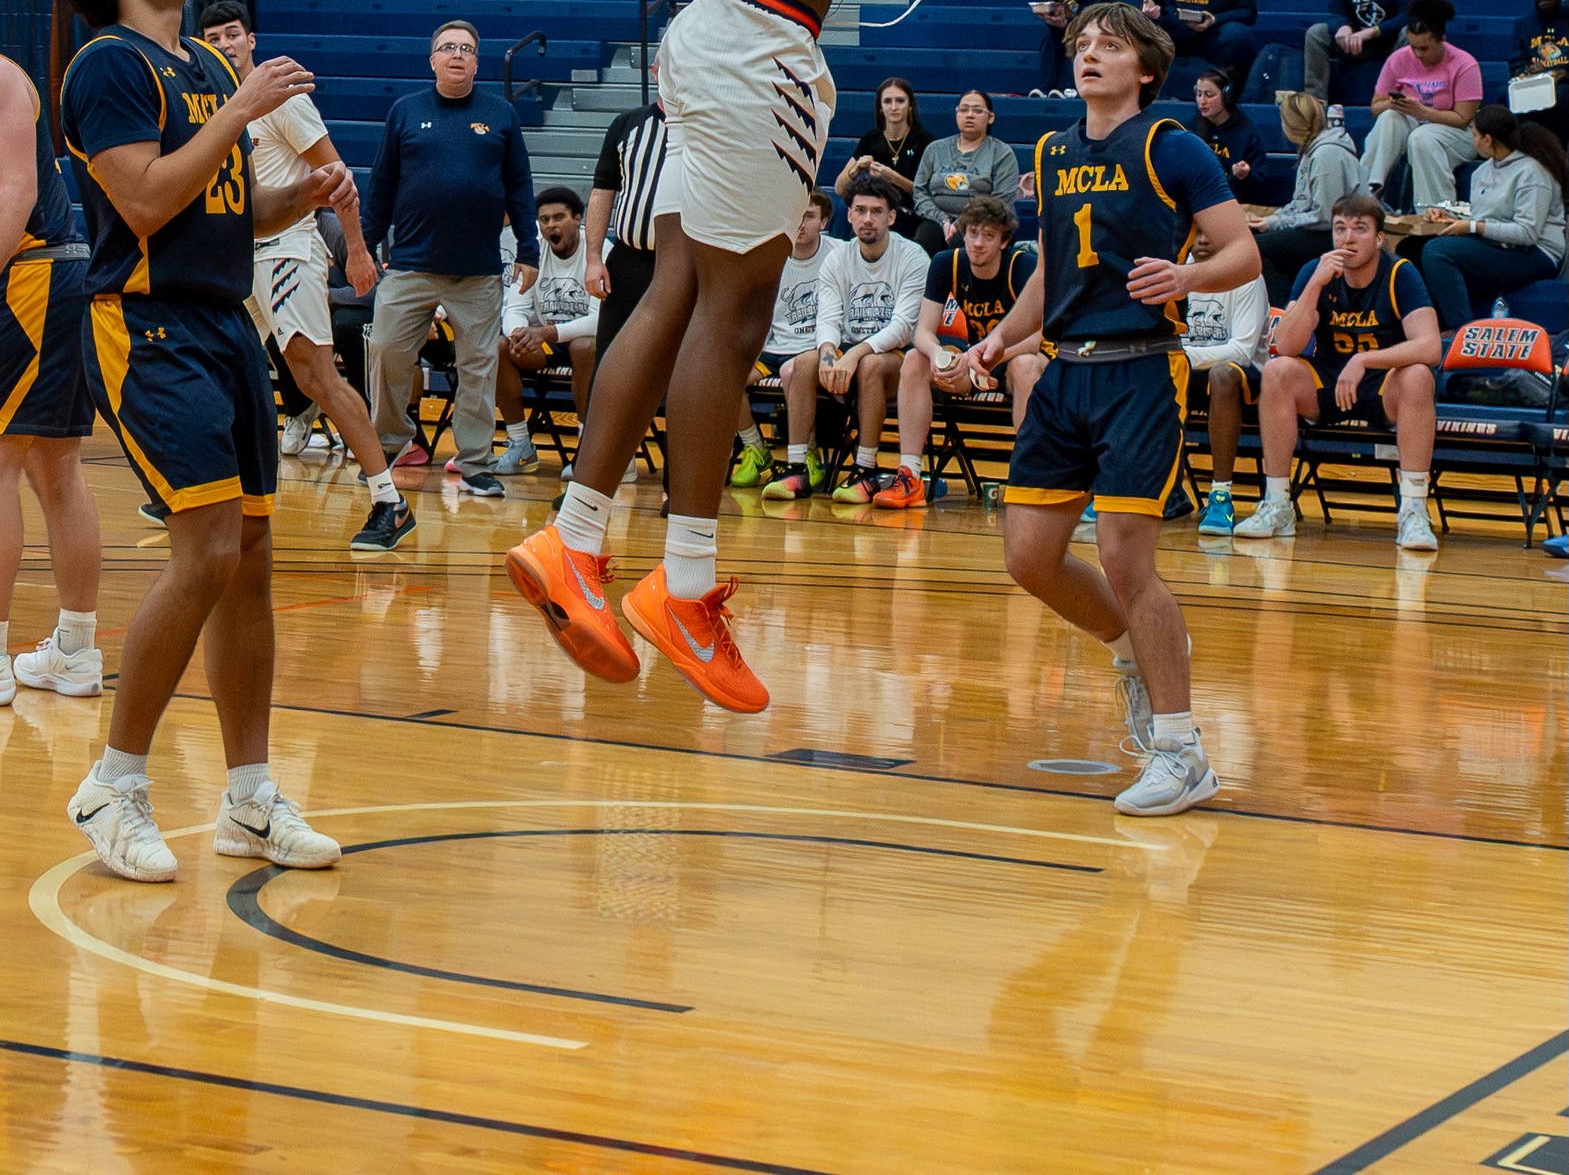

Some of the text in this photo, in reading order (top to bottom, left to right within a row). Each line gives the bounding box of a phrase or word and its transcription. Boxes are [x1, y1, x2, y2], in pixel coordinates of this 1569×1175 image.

[1054, 163, 1130, 197] MCLA
[1073, 202, 1100, 269] 1
[962, 298, 1006, 318] MCLA
[1328, 309, 1380, 327] MCLA
[1333, 332, 1380, 354] 55
[1463, 326, 1540, 344] SALEM
[1461, 341, 1533, 361] STATE
[1436, 419, 1498, 435] VIKINGS
